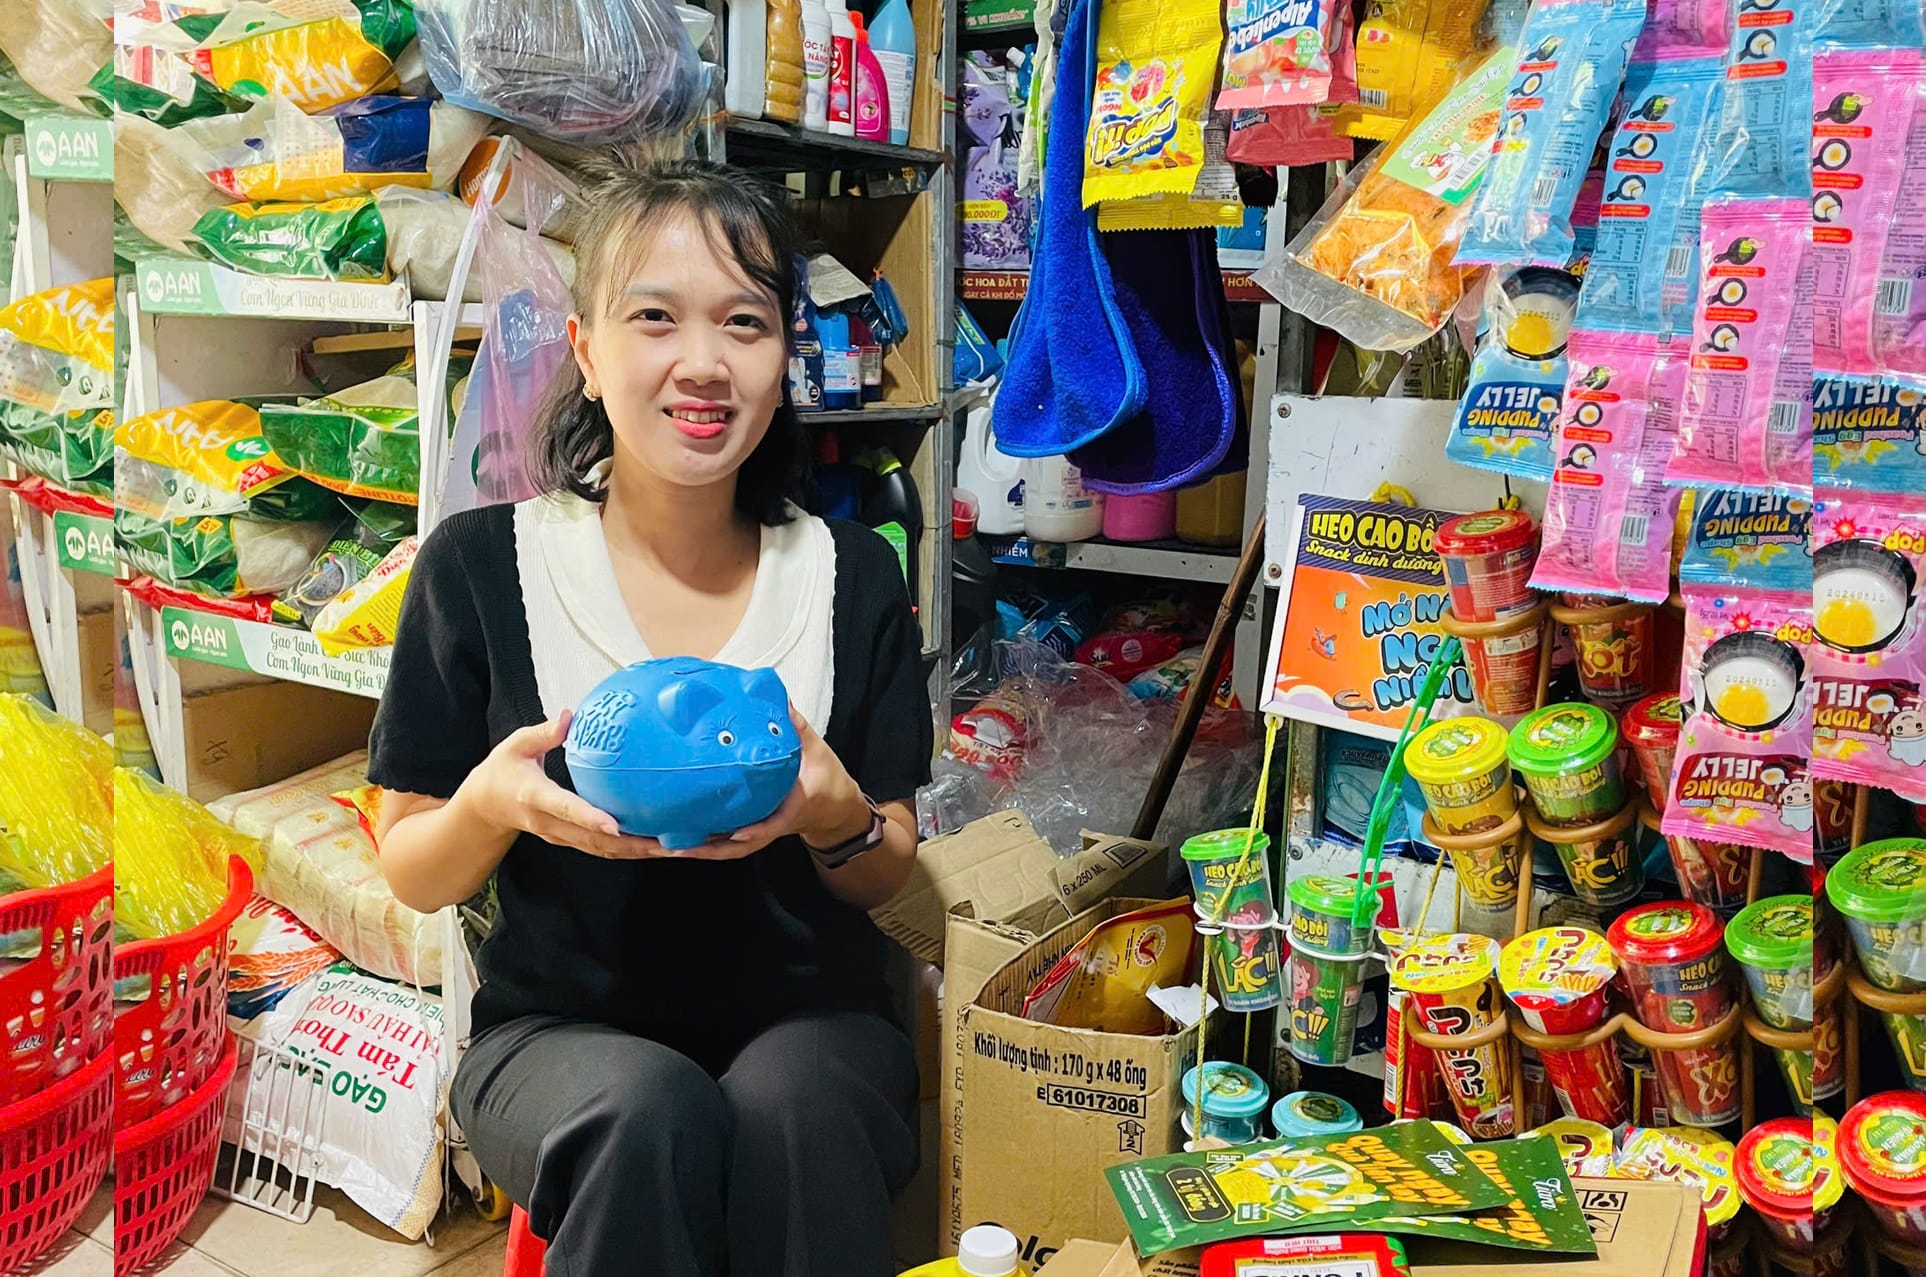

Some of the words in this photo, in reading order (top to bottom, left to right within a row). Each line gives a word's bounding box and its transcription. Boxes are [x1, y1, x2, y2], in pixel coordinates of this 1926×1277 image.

[58, 131, 100, 158] AAN
[166, 271, 201, 295] AAN
[975, 278, 996, 287] HOA
[1476, 386, 1542, 409] JELLY
[1467, 408, 1541, 428] PUDDING
[1311, 512, 1354, 542] HEO
[1357, 514, 1403, 551] CAO
[1405, 516, 1438, 555] BỒ
[1704, 514, 1791, 537] PUDDING
[1305, 539, 1352, 562] Snack
[1354, 549, 1388, 568] dinh
[192, 623, 227, 650] AAN
[1691, 757, 1764, 779] JELLY
[1682, 778, 1766, 800] PUDDING
[1062, 883, 1069, 896] 6
[1070, 881, 1078, 892] x
[1077, 869, 1092, 889] 250
[1680, 963, 1706, 982] HEO
[357, 1043, 416, 1090] Tám
[974, 1032, 996, 1059] Khối
[999, 1037, 1027, 1072] lượng
[1030, 1047, 1050, 1075] tịnh
[1062, 1053, 1084, 1077] 170
[1086, 1064, 1093, 1084] g
[1096, 1065, 1104, 1080] x
[1106, 1059, 1121, 1083] 48
[1125, 1059, 1147, 1090] ống
[331, 1069, 388, 1114] GẠO
[1037, 1087, 1046, 1099] E
[1053, 1089, 1139, 1114] 61017308
[1126, 1138, 1135, 1148] 2
